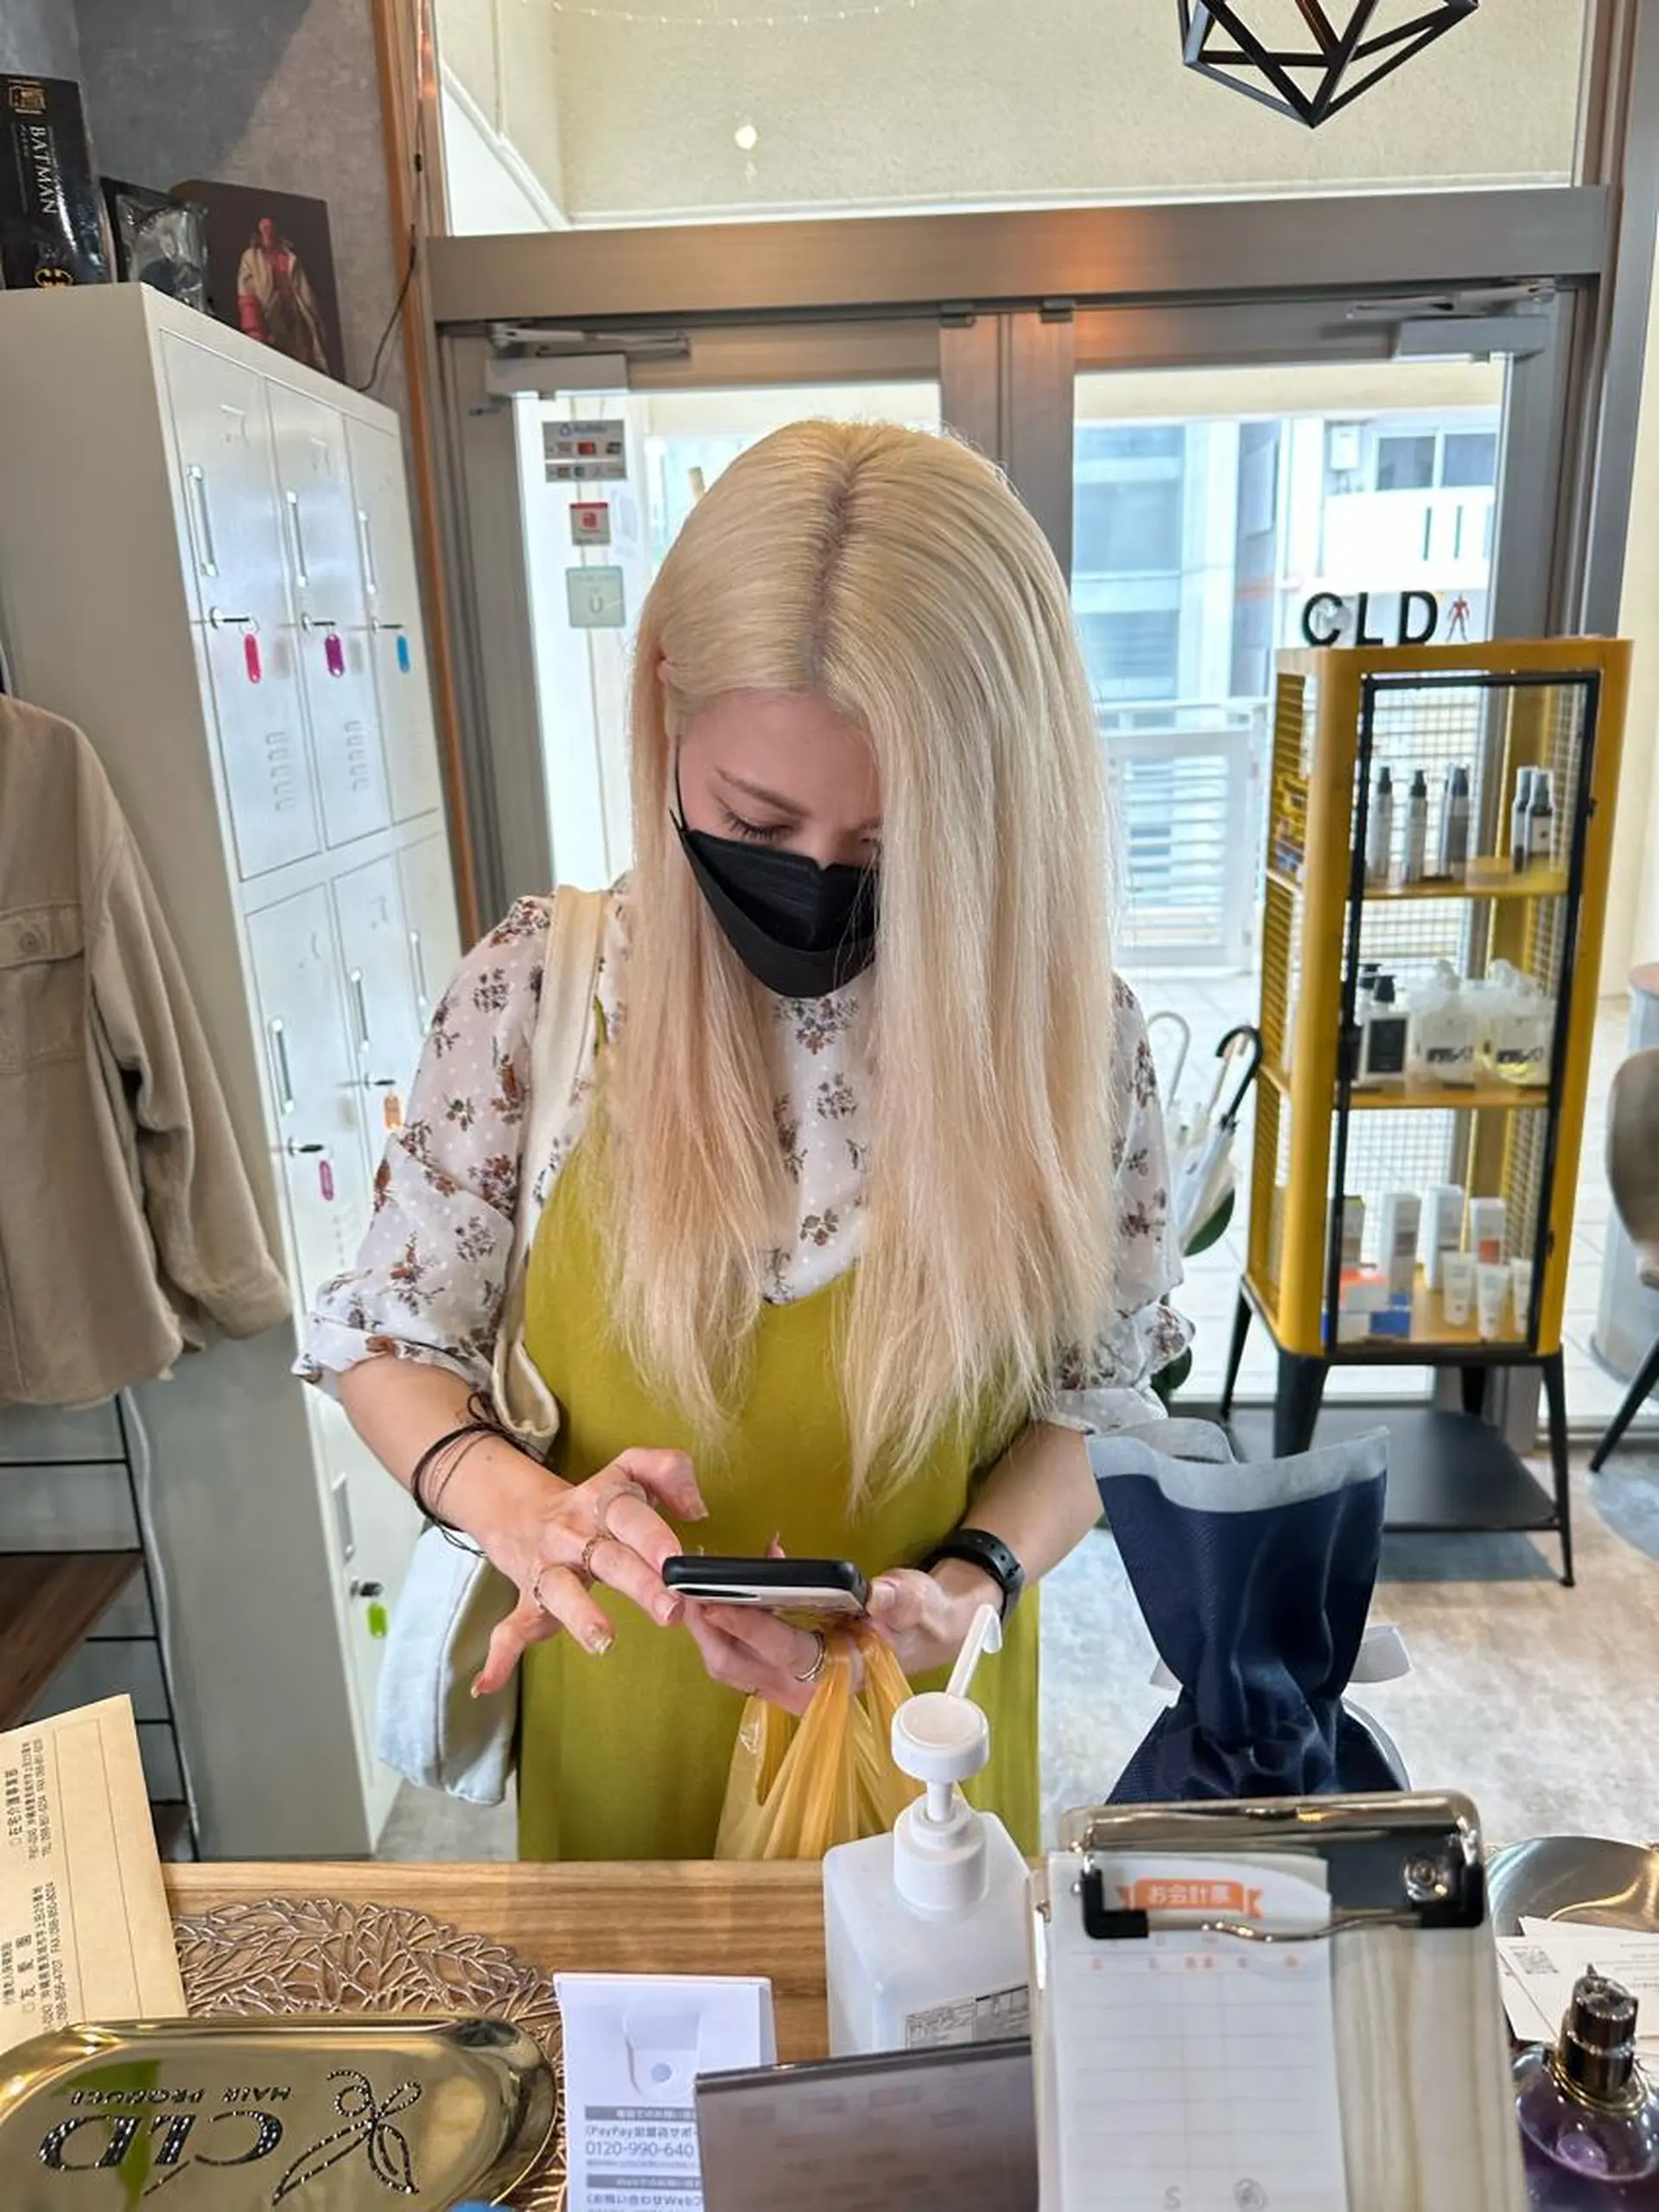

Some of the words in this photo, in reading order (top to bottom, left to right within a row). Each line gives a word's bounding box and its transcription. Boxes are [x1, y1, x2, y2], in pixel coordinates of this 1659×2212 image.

[29, 126, 58, 213] BATMAN
[1301, 591, 1439, 647] CLD
[586, 2140, 695, 2158] 0120-990-640
